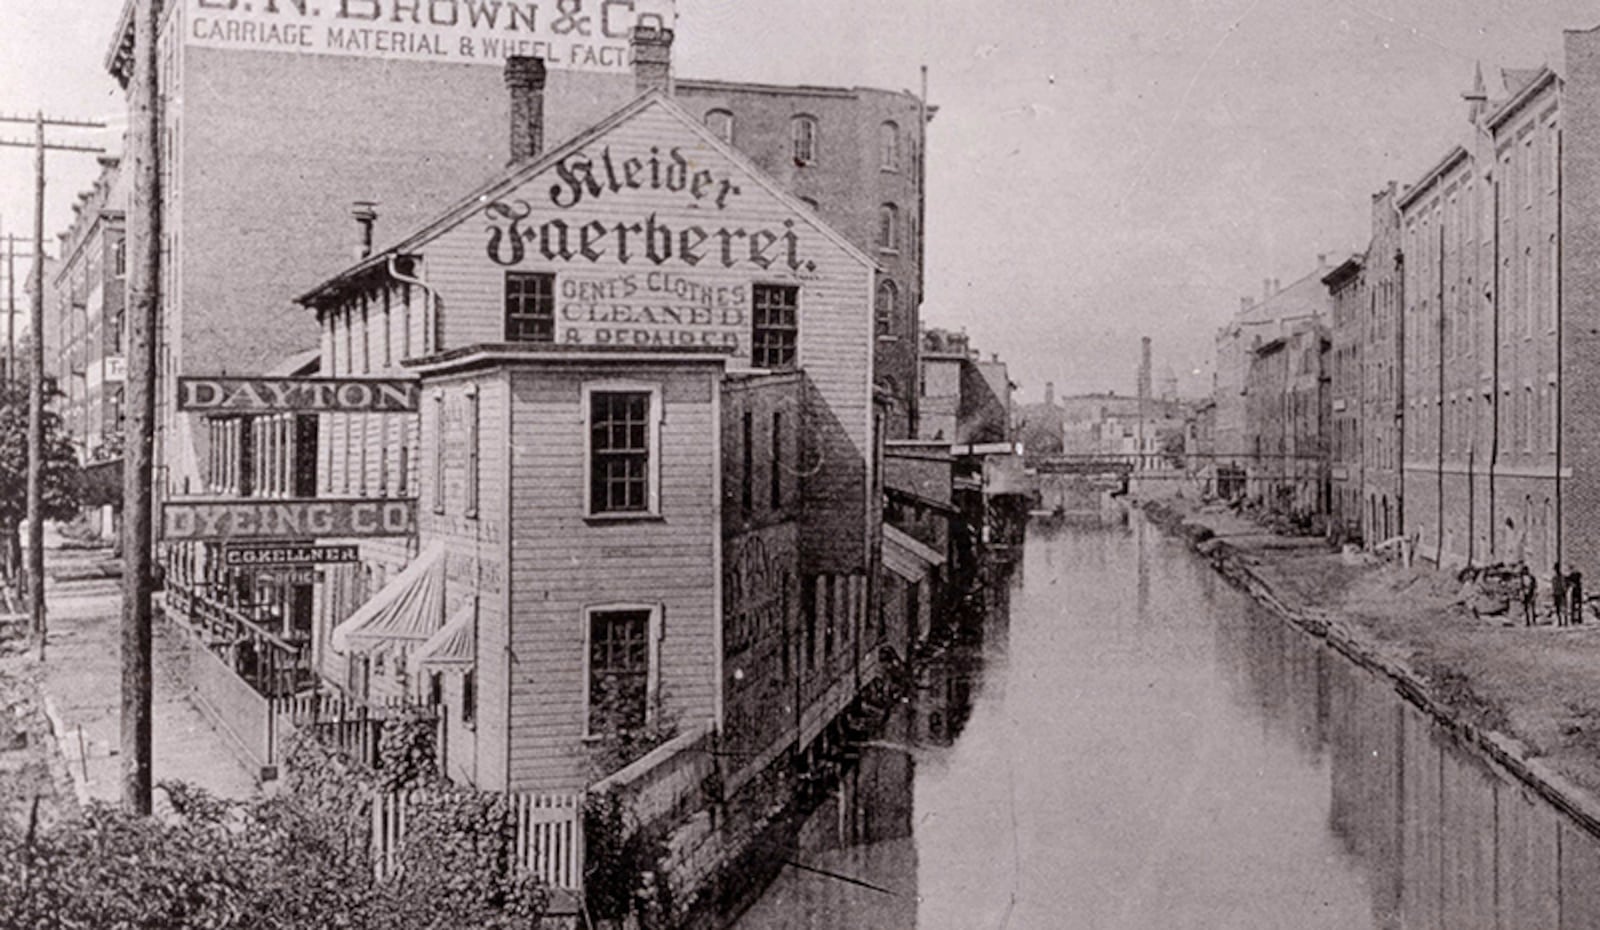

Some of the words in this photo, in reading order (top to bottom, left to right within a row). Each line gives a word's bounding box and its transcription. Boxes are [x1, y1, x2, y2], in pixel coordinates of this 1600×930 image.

[552, 0, 592, 36] &
[193, 18, 313, 47] CARRIAGE
[327, 28, 448, 56] MATERIAL
[460, 36, 475, 57] &
[483, 38, 560, 62] WHEEL
[550, 146, 741, 209] Kleider
[562, 275, 638, 300] GENT'S
[647, 271, 745, 307] CLOTHES
[562, 303, 743, 326] CLEANED
[565, 328, 581, 344] &
[595, 328, 740, 350] REPAIRED
[183, 380, 414, 408] DAYTON
[165, 504, 333, 538] DYEING
